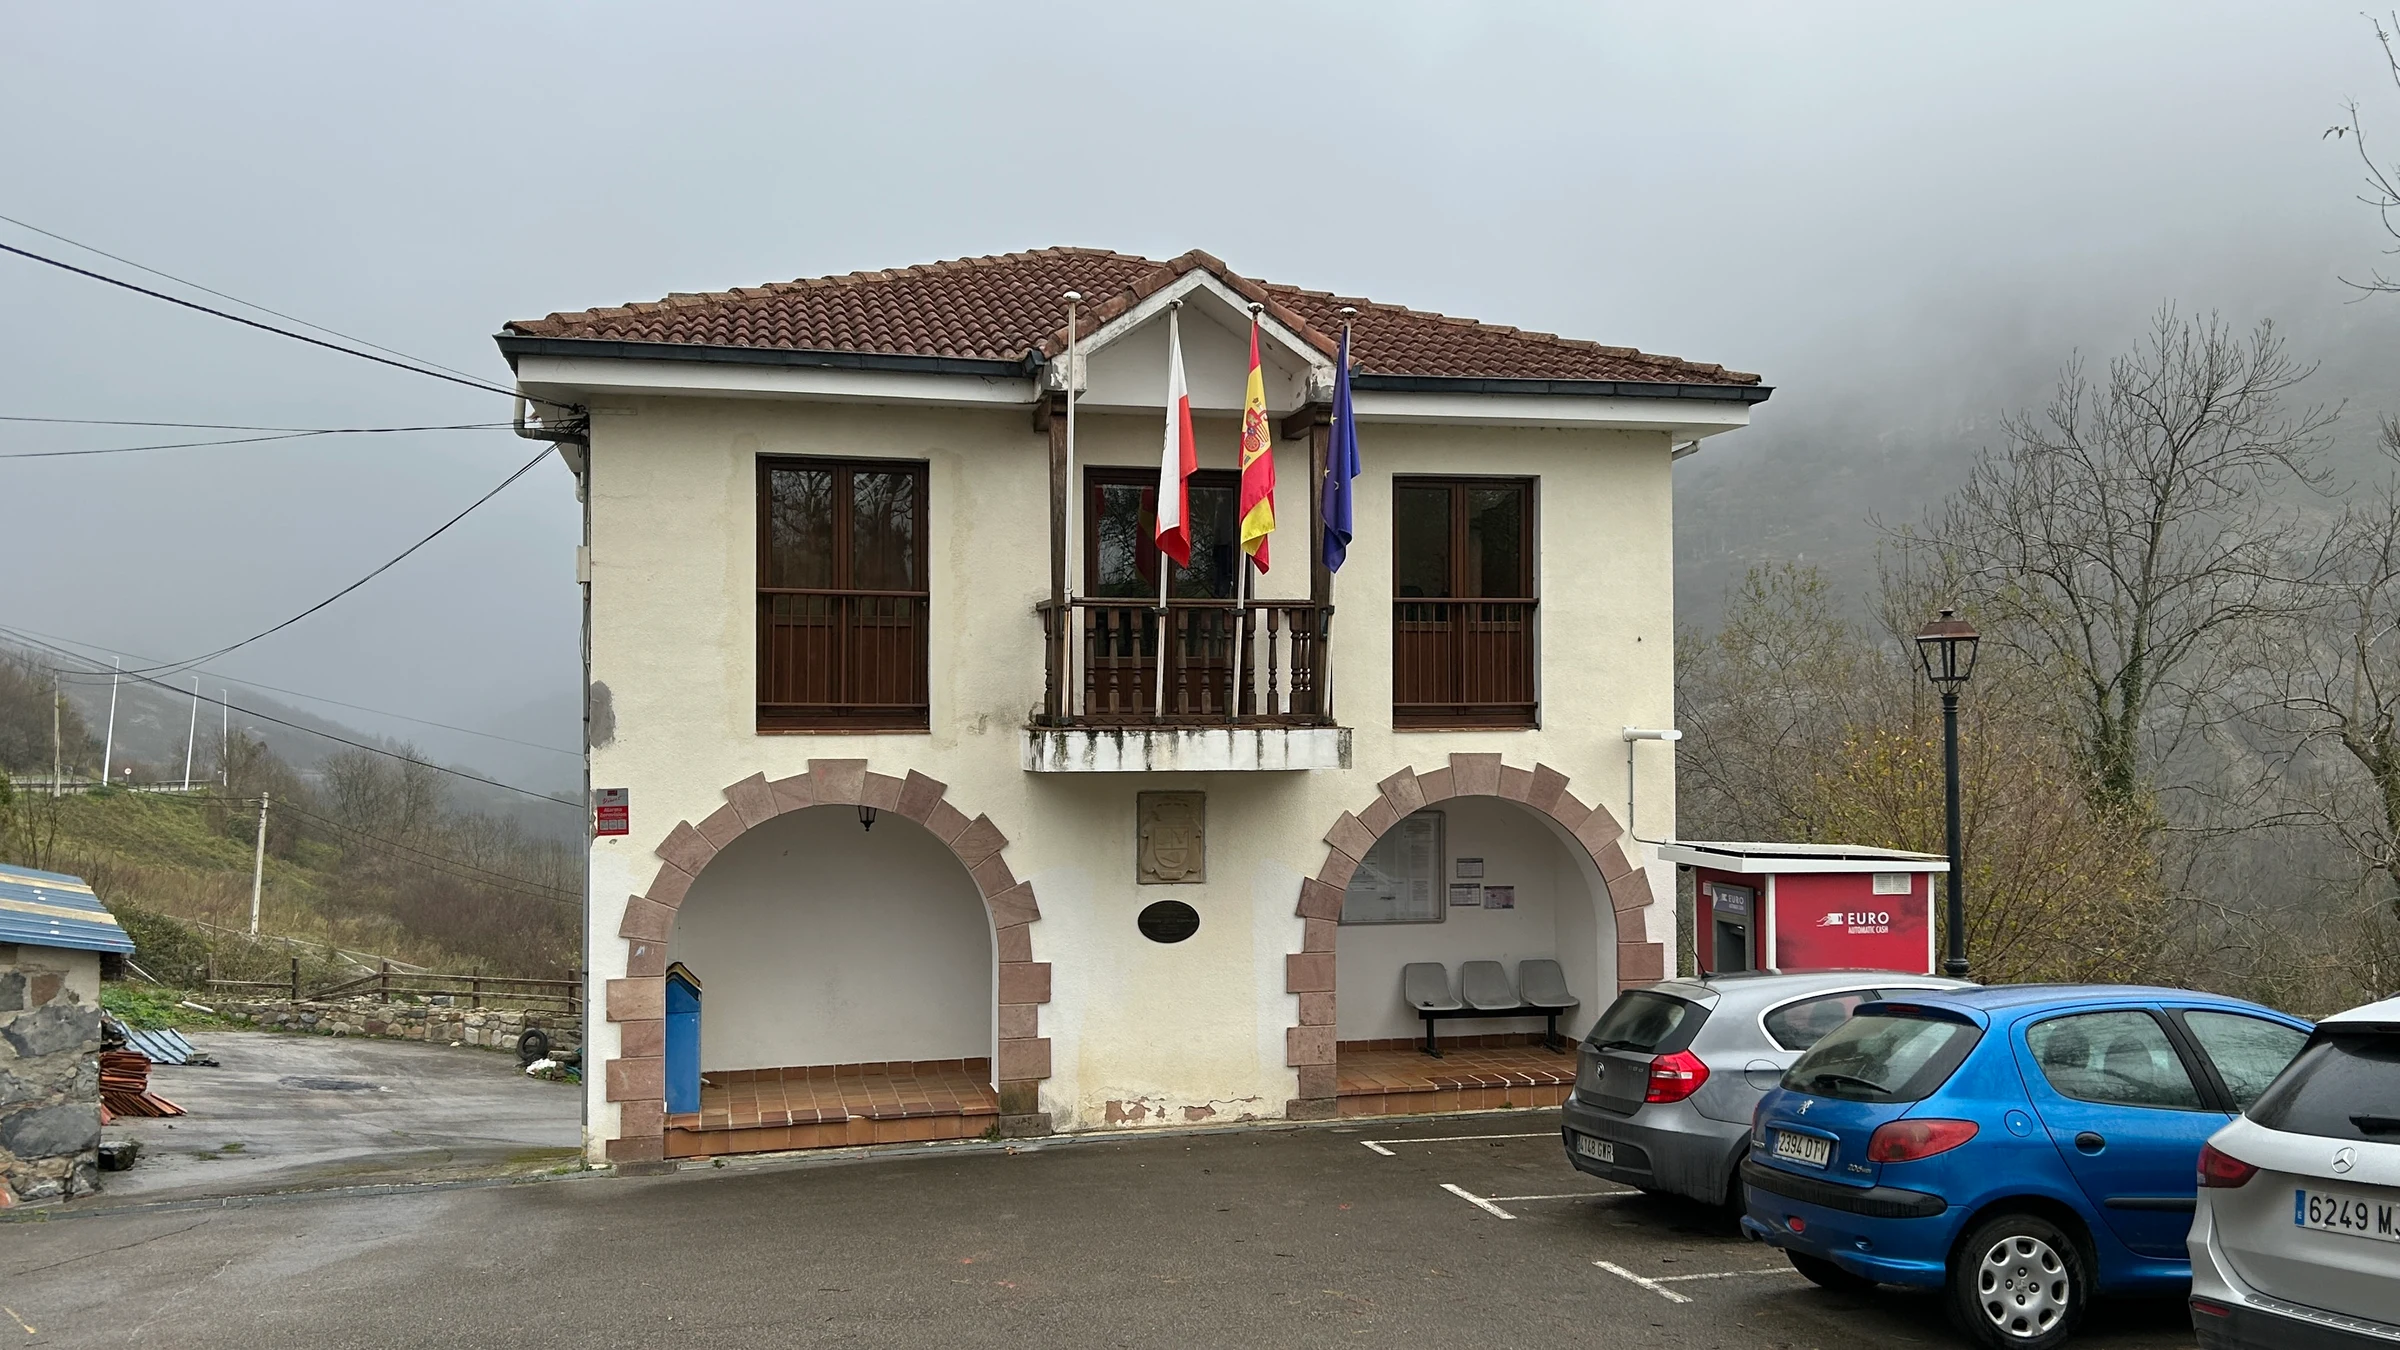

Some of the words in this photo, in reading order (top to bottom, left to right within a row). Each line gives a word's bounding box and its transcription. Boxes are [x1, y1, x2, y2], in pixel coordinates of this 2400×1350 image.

[1728, 894, 1745, 905] EURO
[1847, 911, 1890, 925] EURO
[1847, 925, 1876, 934] AUTOMATIC
[1875, 925, 1889, 934] CASH
[1778, 1132, 1802, 1156] 2394
[1804, 1139, 1828, 1162] DTV
[2309, 1196, 2368, 1231] 6249
